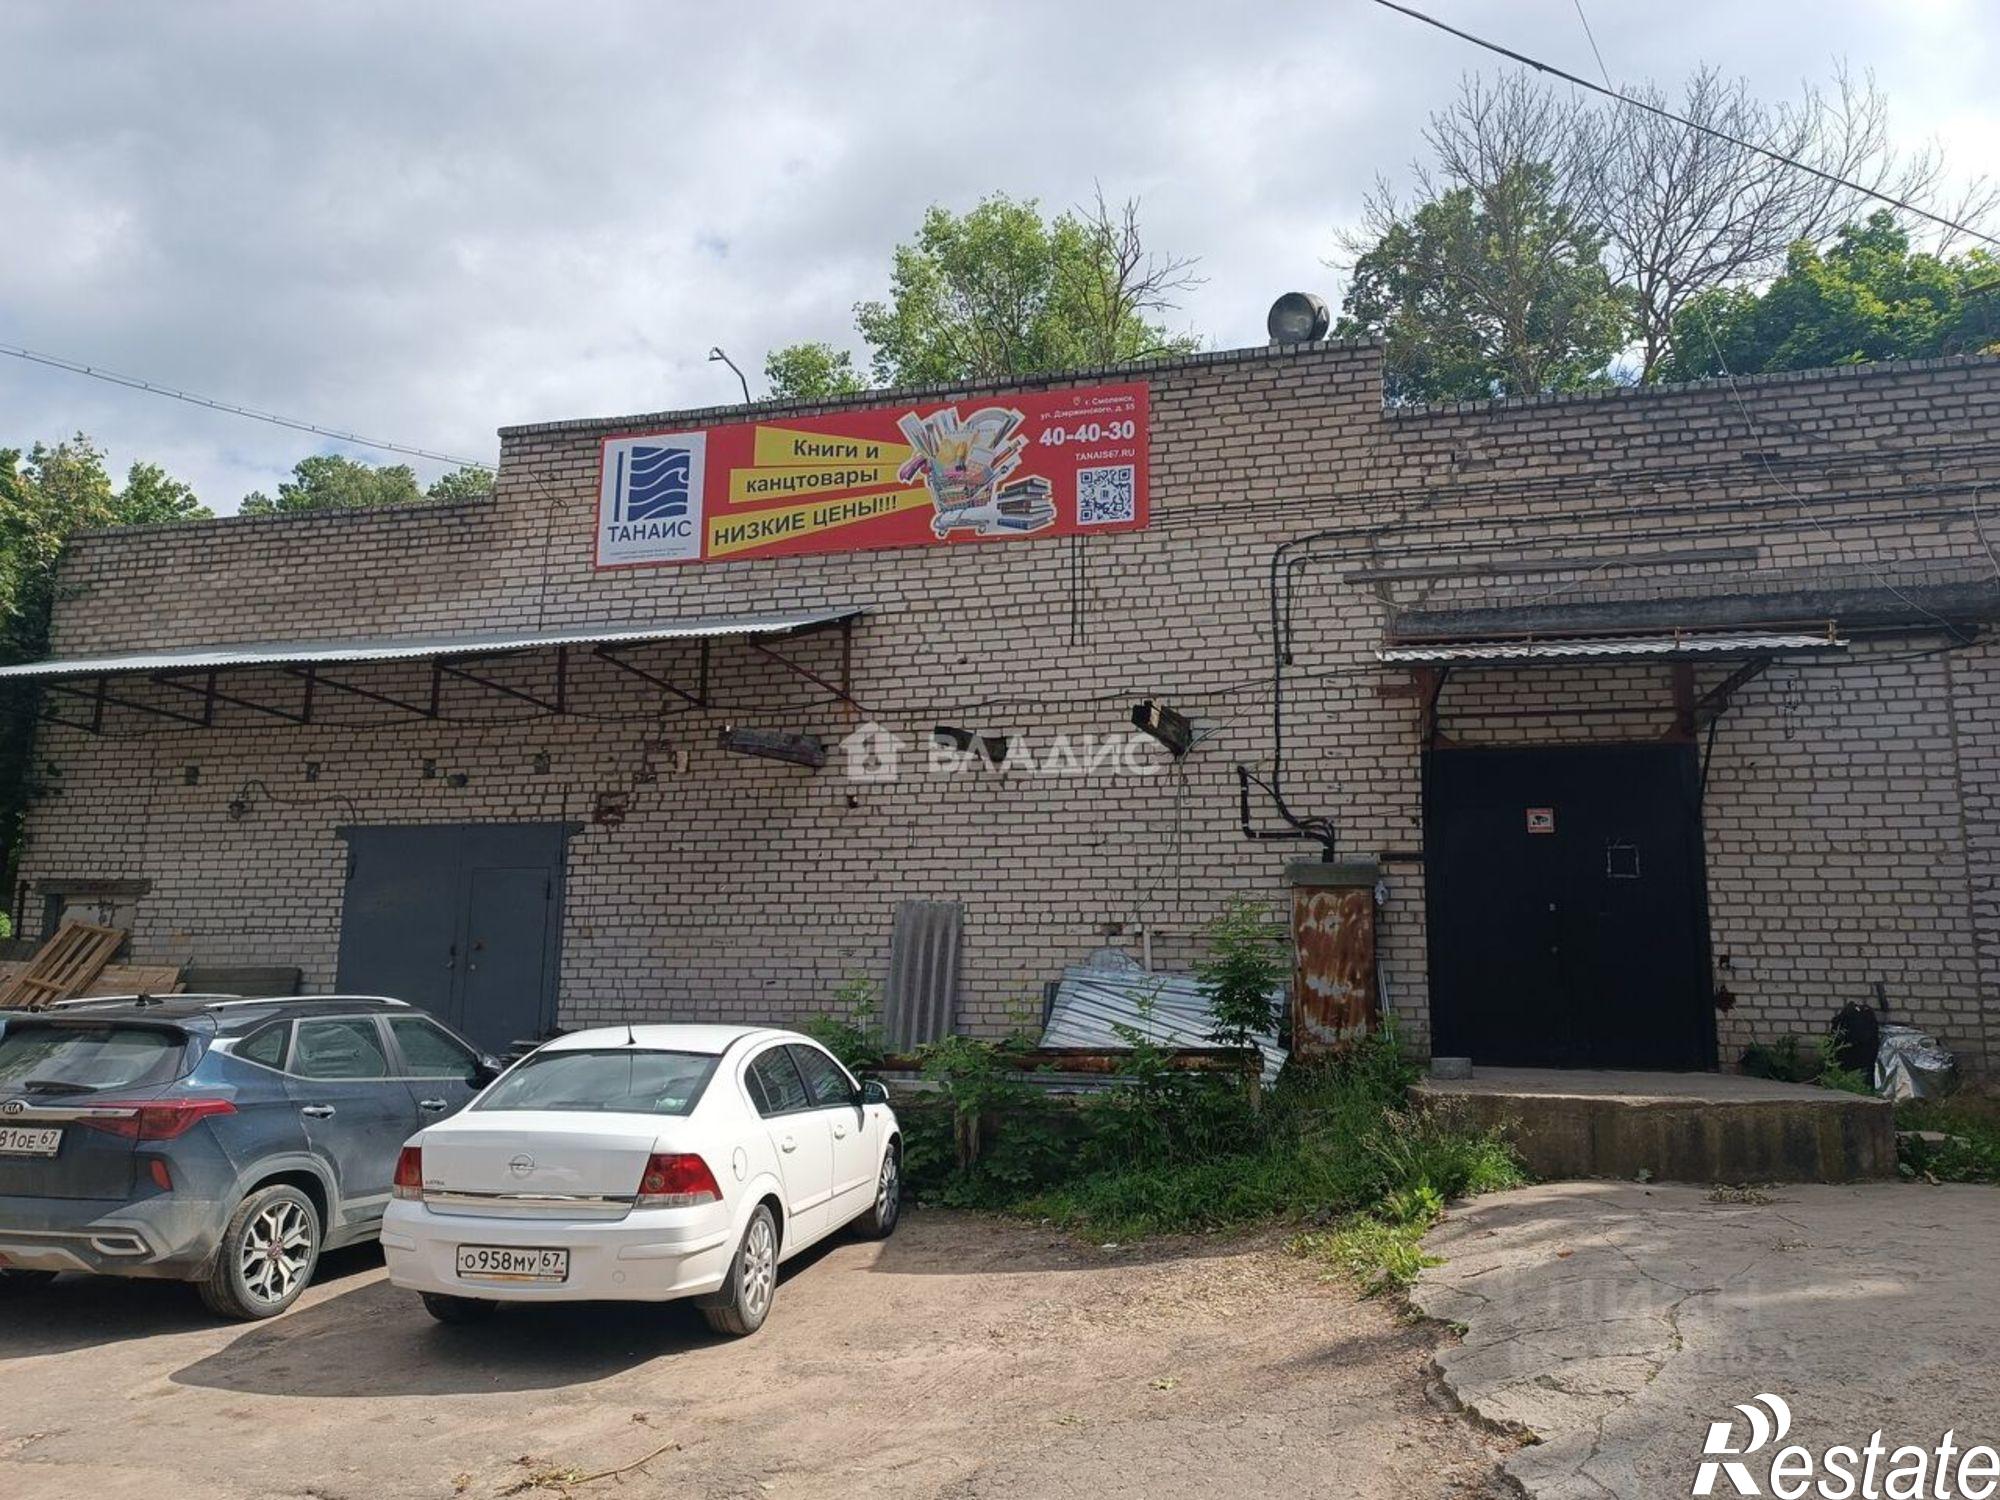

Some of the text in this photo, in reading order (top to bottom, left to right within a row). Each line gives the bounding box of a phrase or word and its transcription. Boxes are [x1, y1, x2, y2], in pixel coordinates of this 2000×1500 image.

[1039, 420, 1136, 446] 40-40-30
[794, 439, 879, 459] Книги и
[1075, 448, 1136, 461] TANAIS67.RU
[746, 468, 878, 493] канцтовары
[714, 495, 897, 546] НИЗКИЕ ЦЕНЫ!!!
[607, 519, 692, 543] ТАНАИС
[4, 1103, 21, 1113] KIA
[40, 1130, 57, 1145] 67
[541, 1252, 561, 1267] 67
